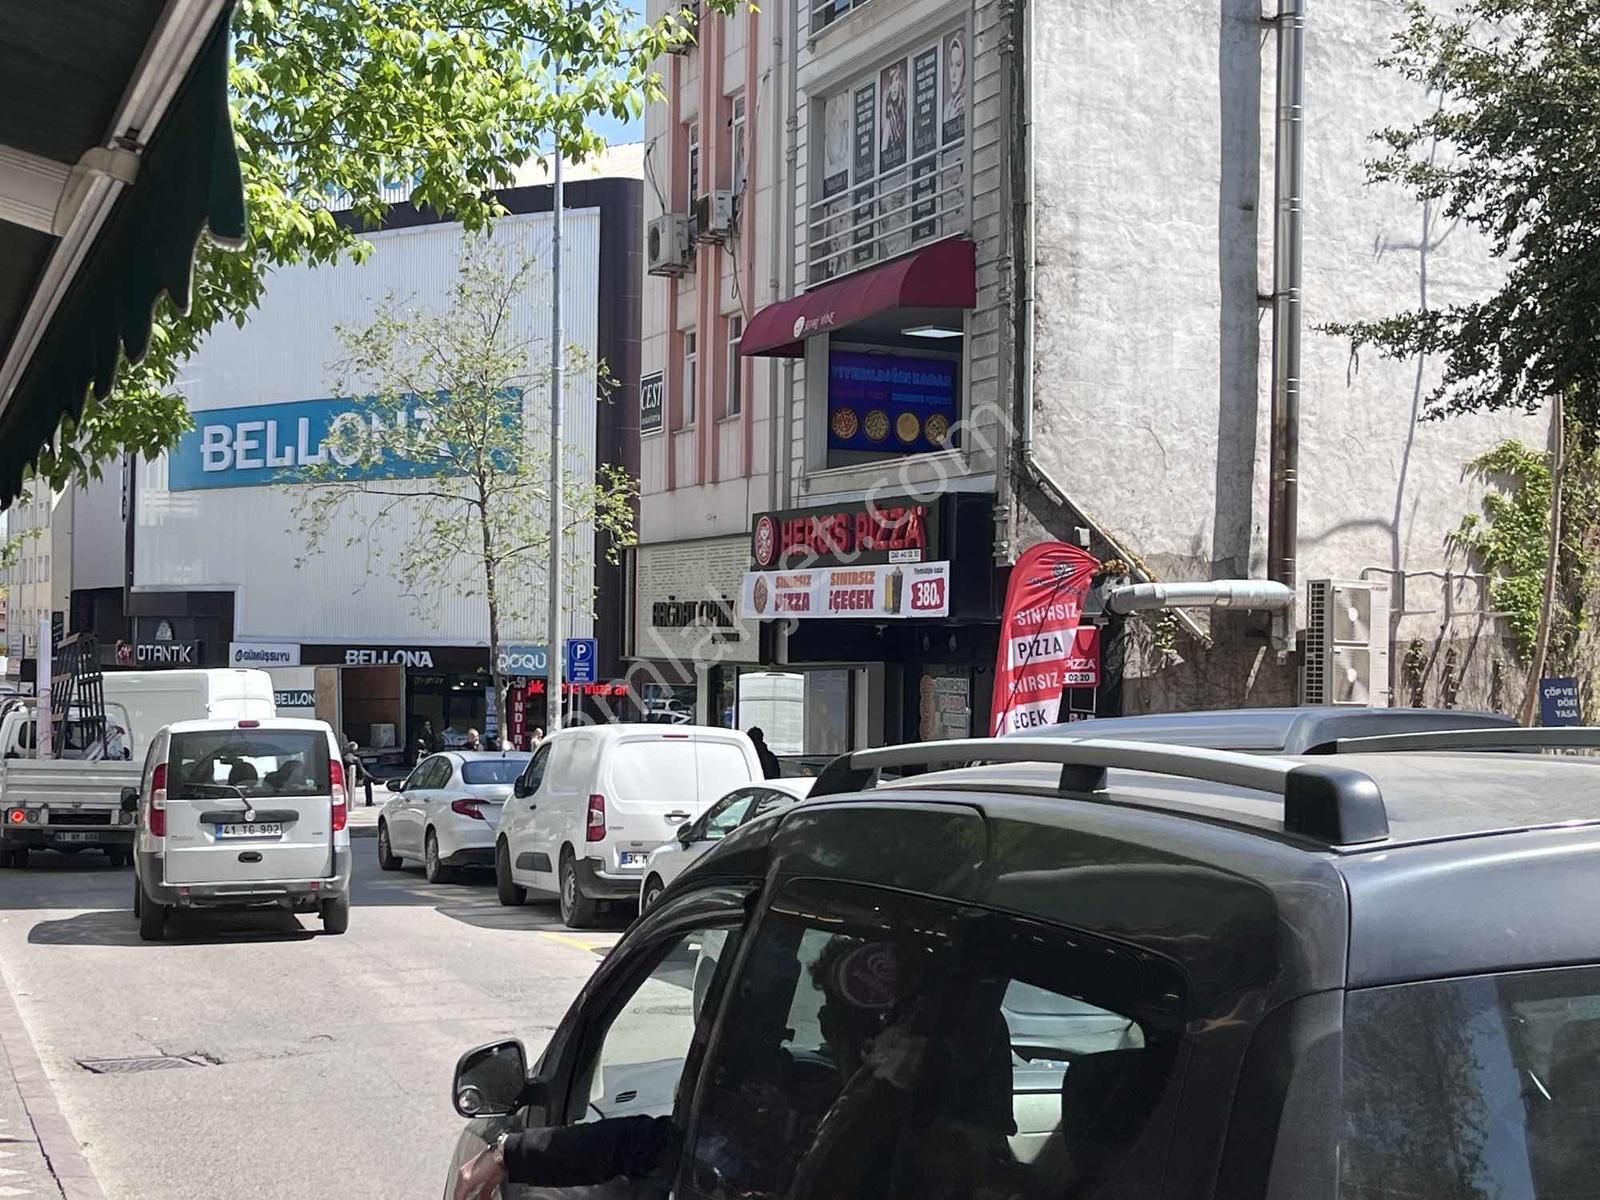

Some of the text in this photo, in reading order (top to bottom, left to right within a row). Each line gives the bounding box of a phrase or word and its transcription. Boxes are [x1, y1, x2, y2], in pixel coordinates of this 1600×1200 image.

[830, 570, 876, 586] SINIRSIZ
[1017, 635, 1063, 660] PIZZA
[345, 650, 434, 668] BELLONA
[224, 824, 236, 835] 41
